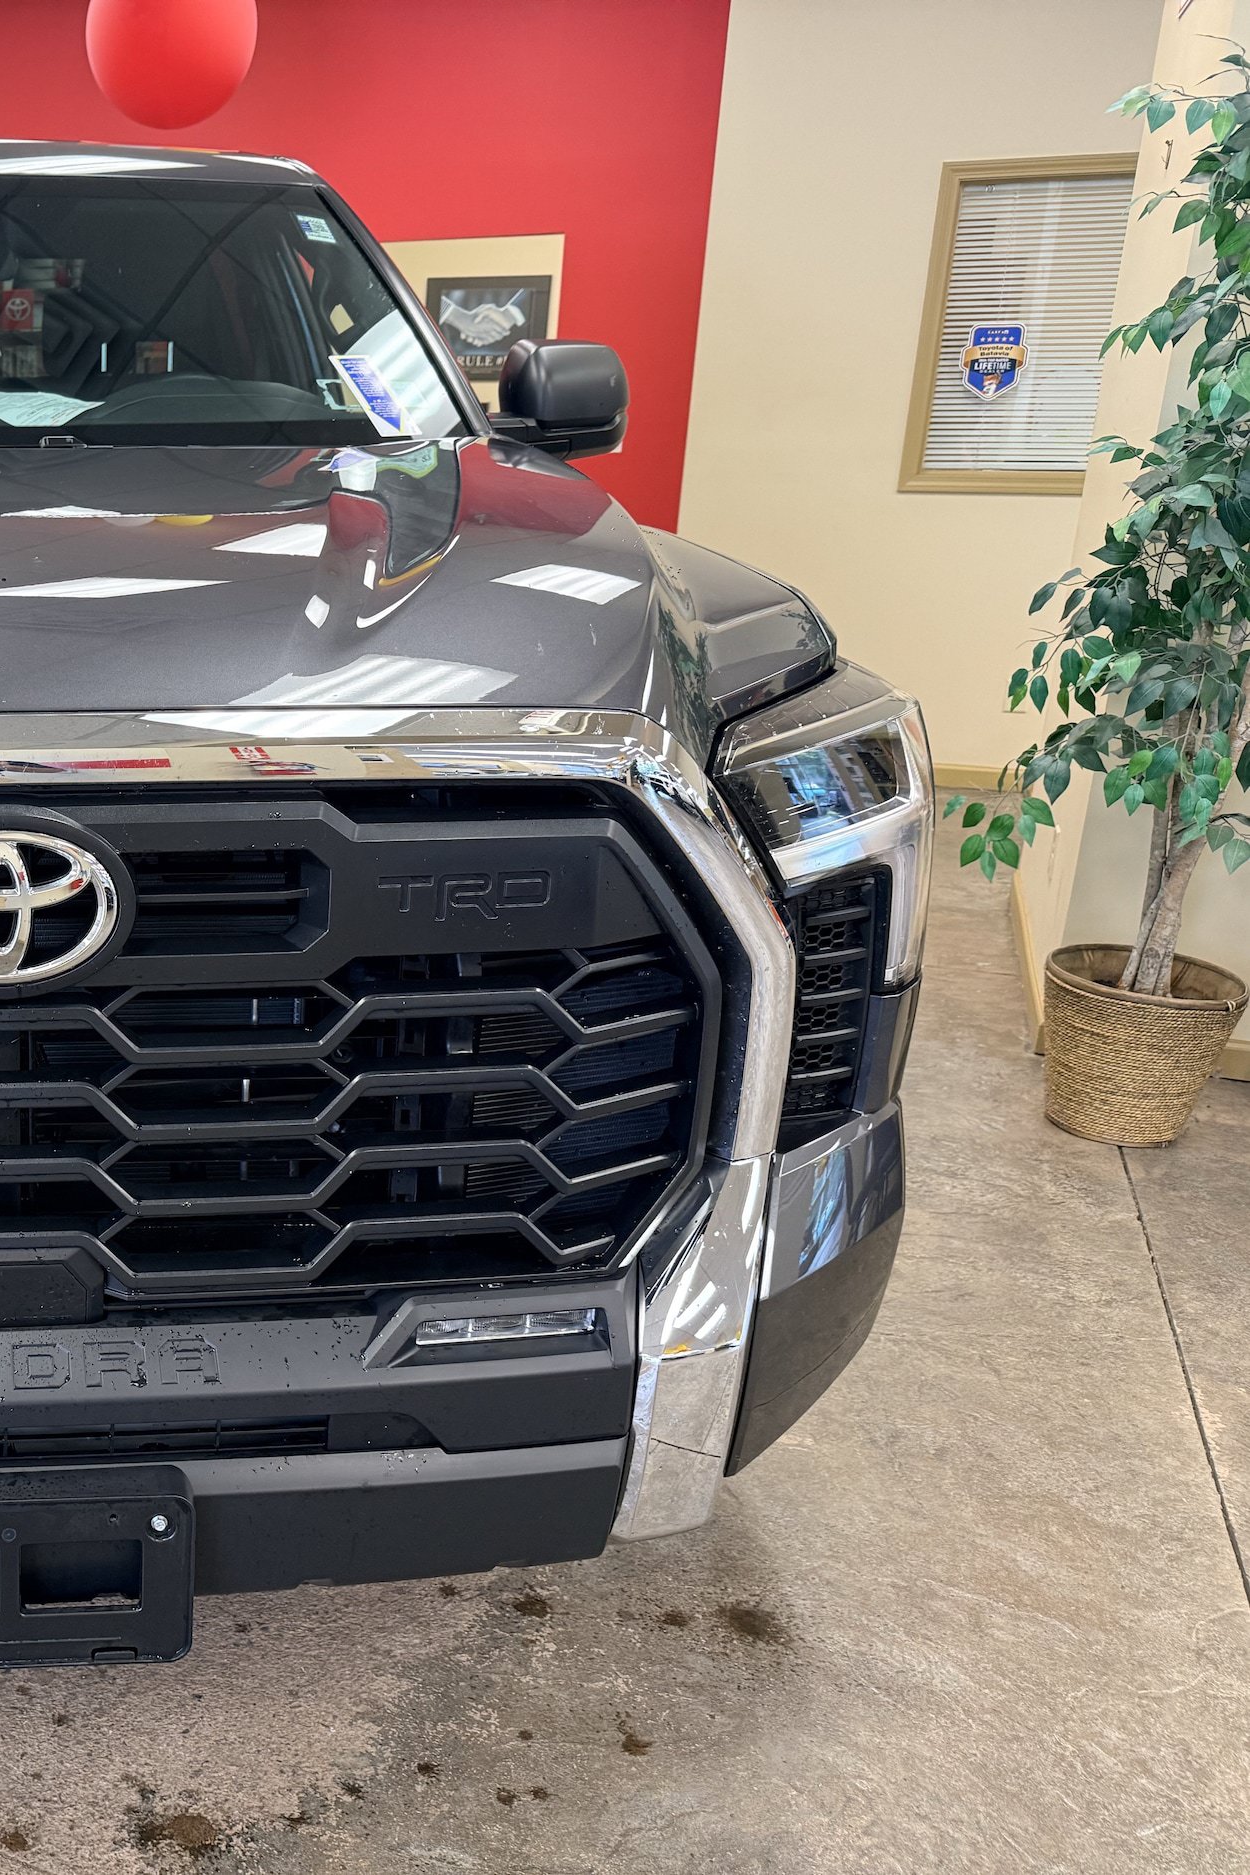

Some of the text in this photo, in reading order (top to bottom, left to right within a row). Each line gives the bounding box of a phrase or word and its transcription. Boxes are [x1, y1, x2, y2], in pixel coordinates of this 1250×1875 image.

[456, 355, 494, 367] RULE
[973, 361, 1012, 370] LIFETIME
[377, 870, 551, 922] TRD
